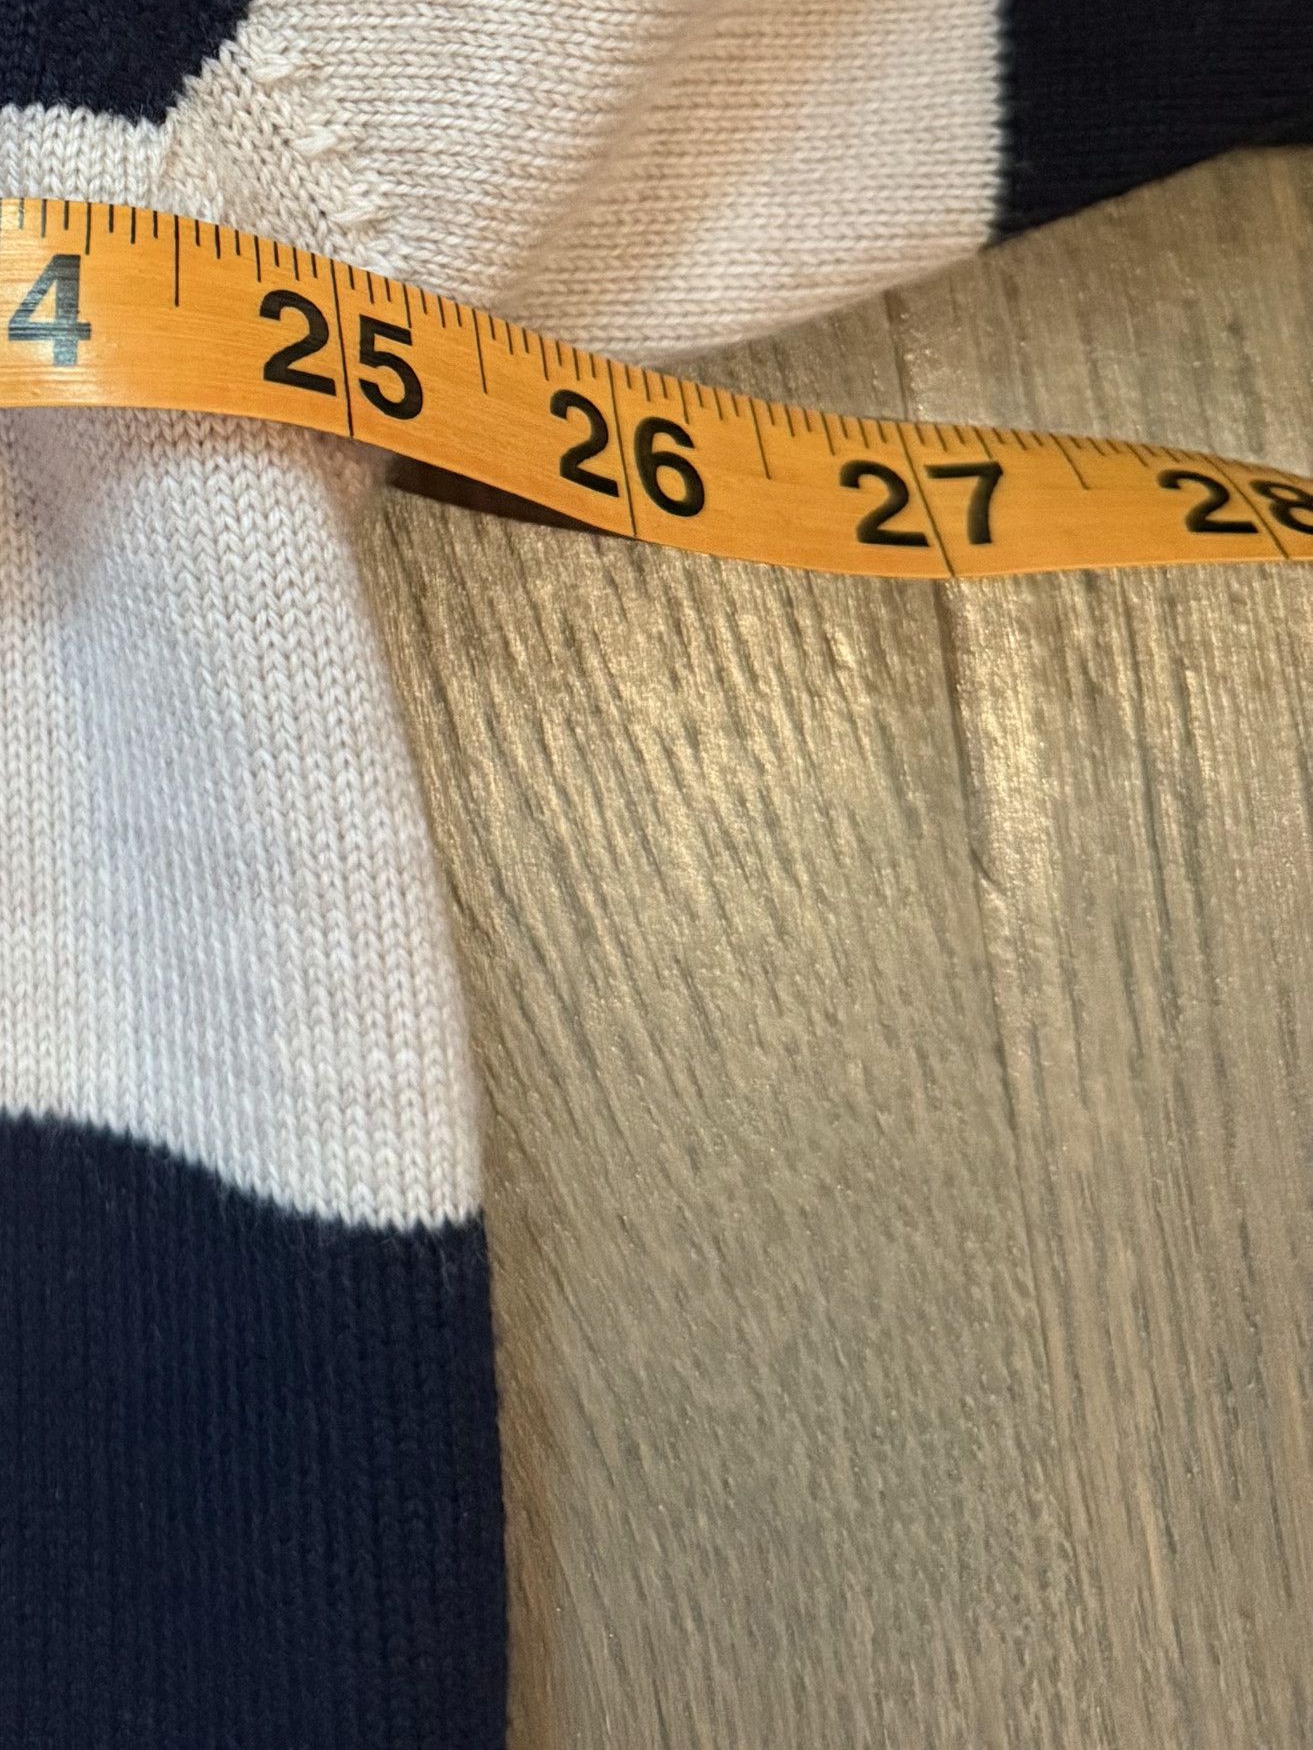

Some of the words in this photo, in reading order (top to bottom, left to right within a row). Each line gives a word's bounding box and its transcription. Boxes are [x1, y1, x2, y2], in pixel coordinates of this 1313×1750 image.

[258, 288, 425, 421] 25
[548, 388, 707, 519] 26
[838, 459, 1006, 548] 27
[1156, 468, 1313, 537] 28
